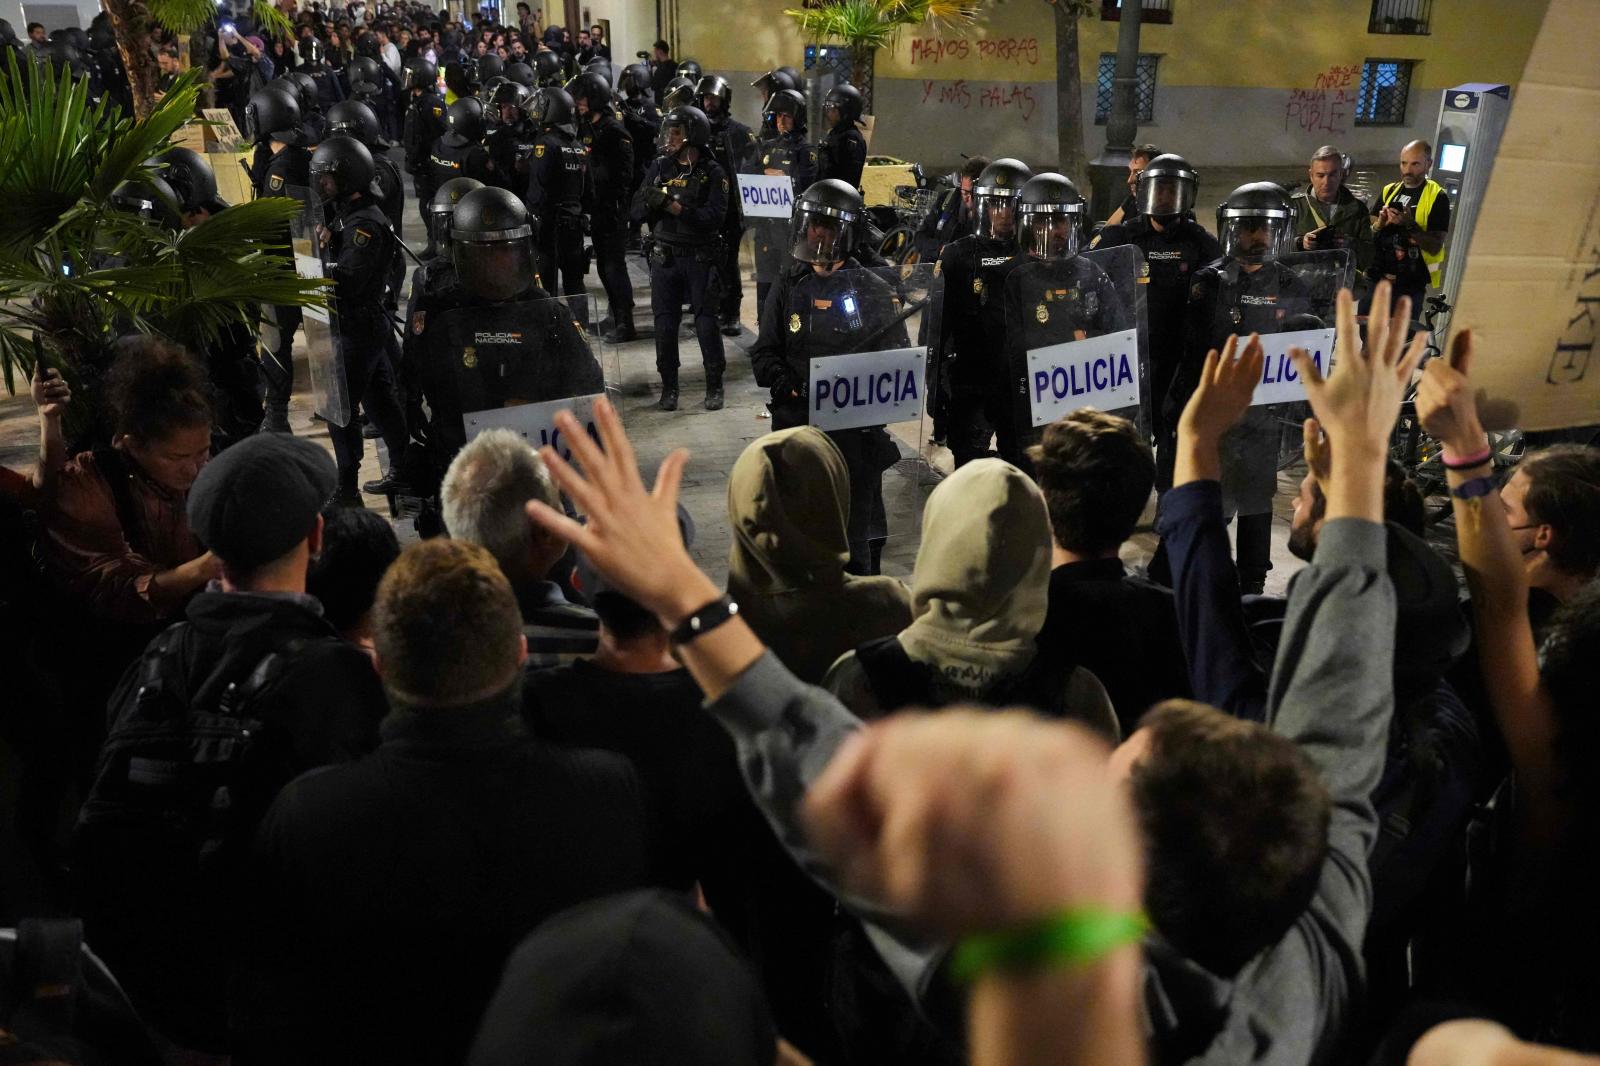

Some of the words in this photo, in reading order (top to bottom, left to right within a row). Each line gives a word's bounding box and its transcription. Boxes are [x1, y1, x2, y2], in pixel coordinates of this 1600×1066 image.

[911, 38, 970, 64] MENOS
[976, 38, 1038, 65] PORRAS
[922, 80, 933, 103] Y
[980, 85, 1036, 120] PALAS
